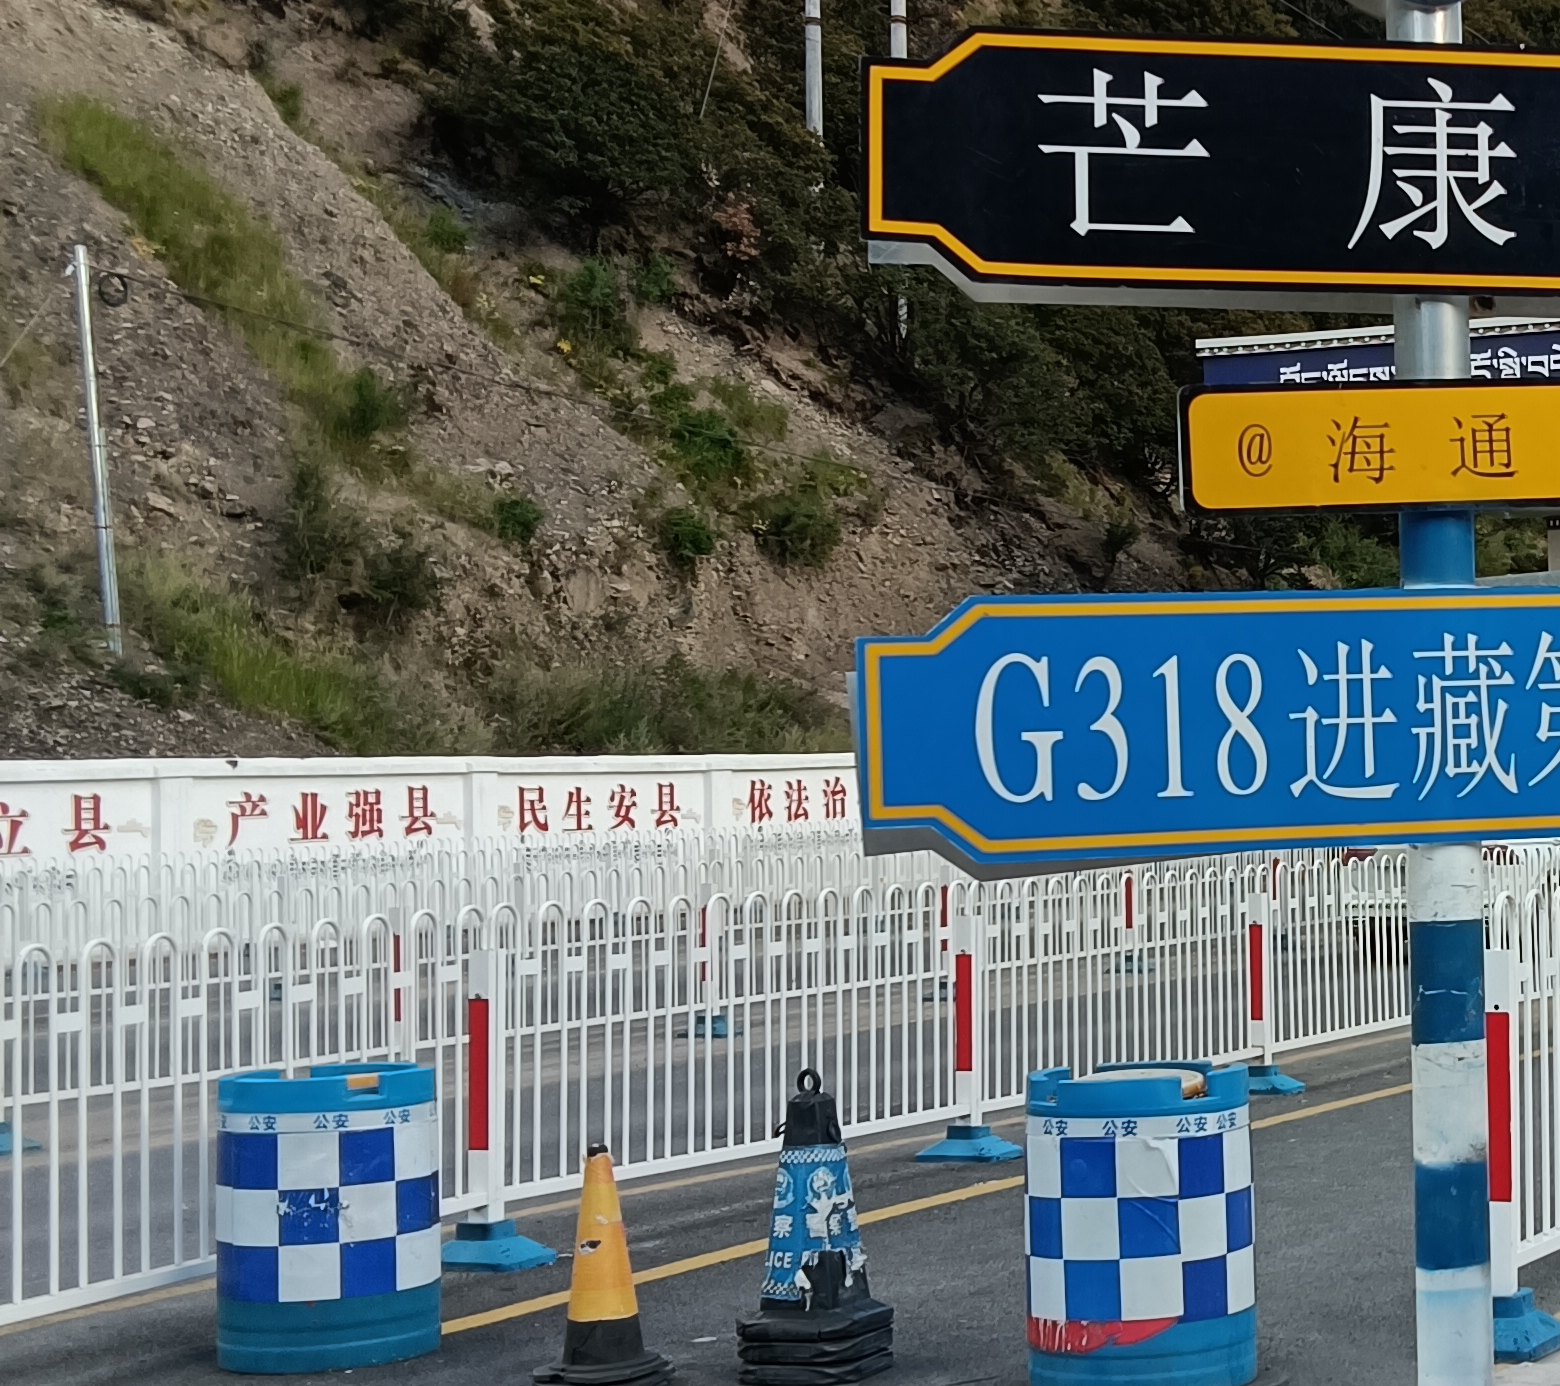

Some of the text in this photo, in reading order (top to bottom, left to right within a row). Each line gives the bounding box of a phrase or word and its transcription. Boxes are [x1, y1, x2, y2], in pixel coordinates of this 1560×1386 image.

[226, 784, 437, 846] 产业强县
[517, 782, 681, 833] 民生安县
[747, 777, 847, 824] 依法治
[249, 1115, 277, 1131] 公安
[313, 1114, 349, 1129] 公安
[383, 1108, 411, 1125] 公安
[1043, 1112, 1237, 1137] 公安 公安 公安 公安
